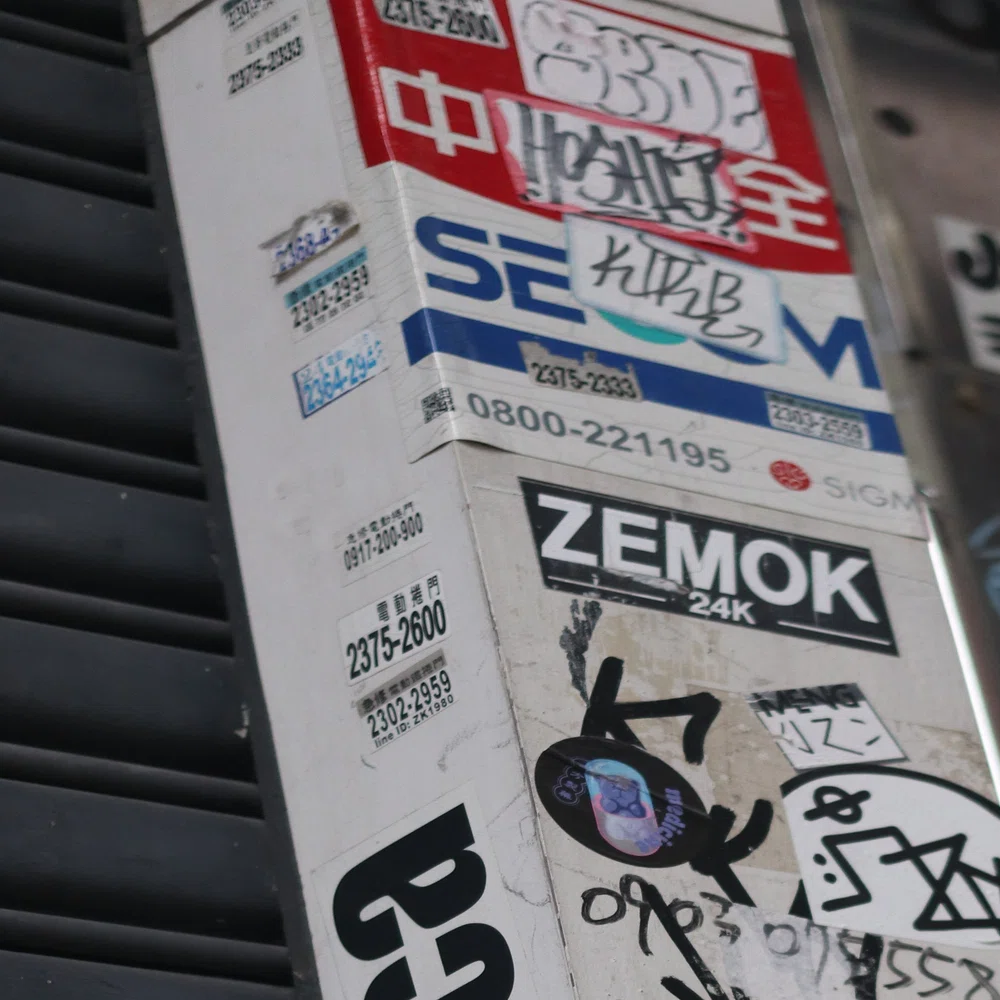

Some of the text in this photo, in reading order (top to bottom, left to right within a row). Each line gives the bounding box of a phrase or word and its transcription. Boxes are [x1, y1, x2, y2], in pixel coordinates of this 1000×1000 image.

[414, 215, 886, 391] SEM
[530, 361, 637, 399] 2375-2333
[466, 393, 732, 474] 0800-221195
[343, 512, 424, 571] 0917-200-900
[536, 493, 880, 625] ZEMOK
[345, 599, 447, 681] 2375-2600
[688, 591, 758, 625] 24K
[366, 669, 452, 739] 2302-2959
[374, 693, 454, 748] line ID: ZK1980
